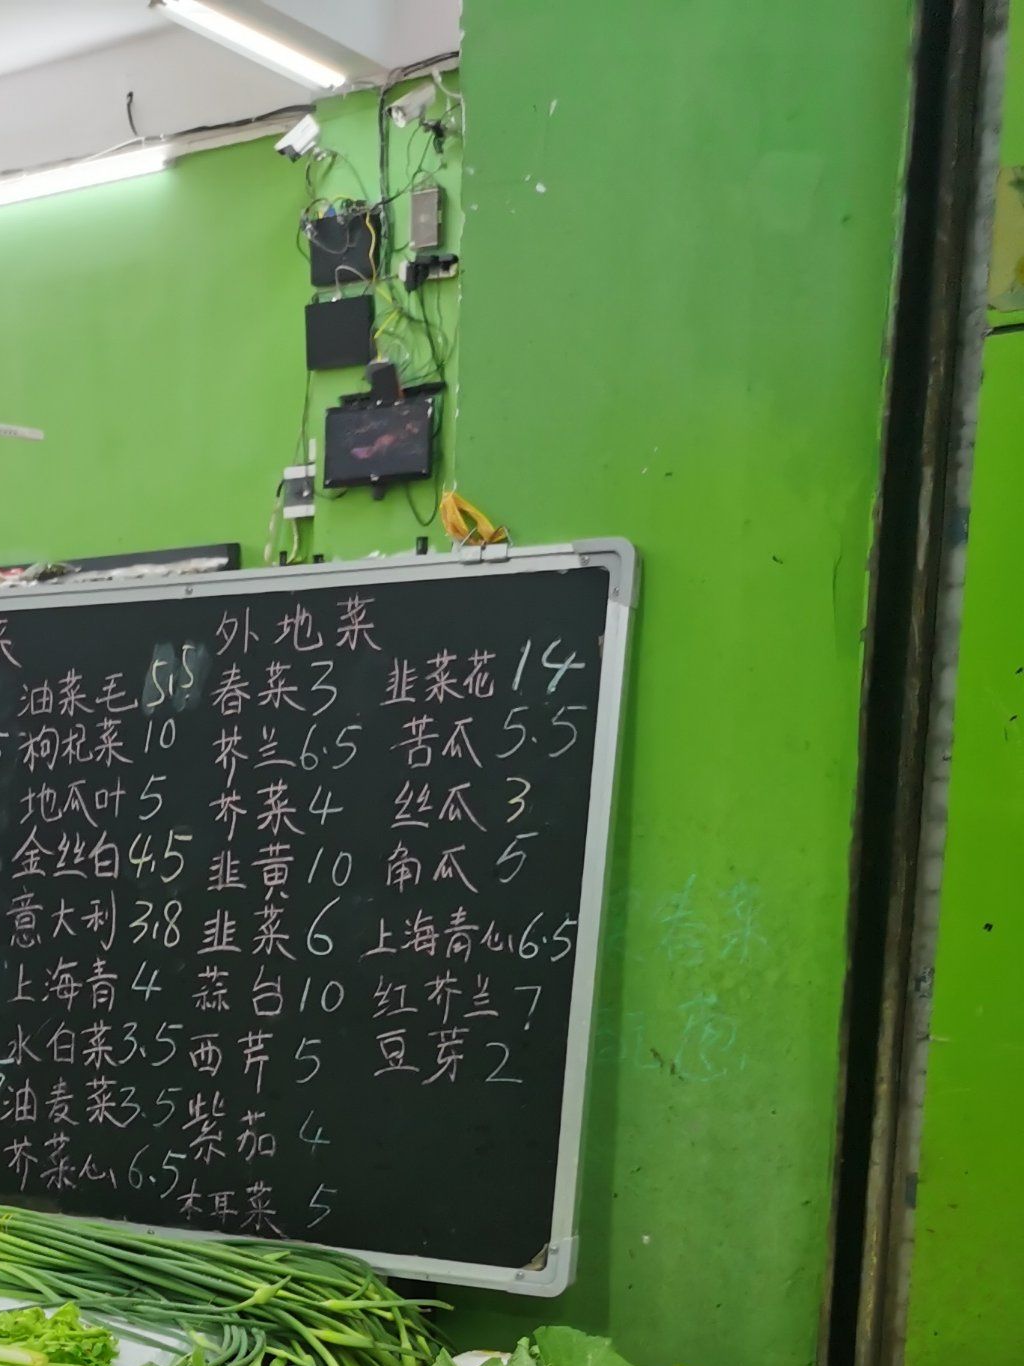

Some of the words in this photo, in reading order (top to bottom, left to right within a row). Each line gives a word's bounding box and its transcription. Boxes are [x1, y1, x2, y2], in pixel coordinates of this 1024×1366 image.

[216, 594, 382, 656] 外地菜
[210, 661, 306, 716] 春菜
[310, 661, 337, 716] 3
[379, 648, 496, 706] 韭菜花
[511, 638, 585, 695] 14
[144, 720, 175, 752] 10
[212, 725, 296, 788] 芥兰
[299, 723, 362, 771] 6.5
[389, 714, 483, 769] 苦瓜
[496, 706, 588, 759] 5.5
[19, 777, 127, 828] 地瓜叶
[139, 775, 167, 820] 5
[208, 778, 306, 841] 芥菜
[309, 785, 343, 825] 4
[390, 780, 487, 832] 丝瓜
[505, 777, 532, 823] 3
[207, 842, 294, 900] 韭黄
[308, 847, 352, 887] 10
[495, 832, 539, 883] 5
[6, 889, 117, 950] 意大利
[197, 904, 297, 961] 韭菜
[306, 896, 341, 957] 6
[518, 911, 577, 962] 6.5
[7, 956, 119, 1012] 上海青
[130, 961, 162, 1002] 4
[299, 976, 345, 1014] 10
[513, 985, 542, 1031] 7
[7, 1019, 118, 1070] 水白菜
[118, 1022, 183, 1067] 3.5
[189, 1030, 273, 1094] 西芹
[295, 1038, 322, 1084] 5
[374, 1028, 470, 1086] 豆芽
[485, 1042, 523, 1084] 2
[0, 1075, 124, 1127] 油麦菜
[299, 1110, 331, 1153] 4
[128, 1144, 187, 1199] 6.5
[307, 1183, 338, 1228] 5
